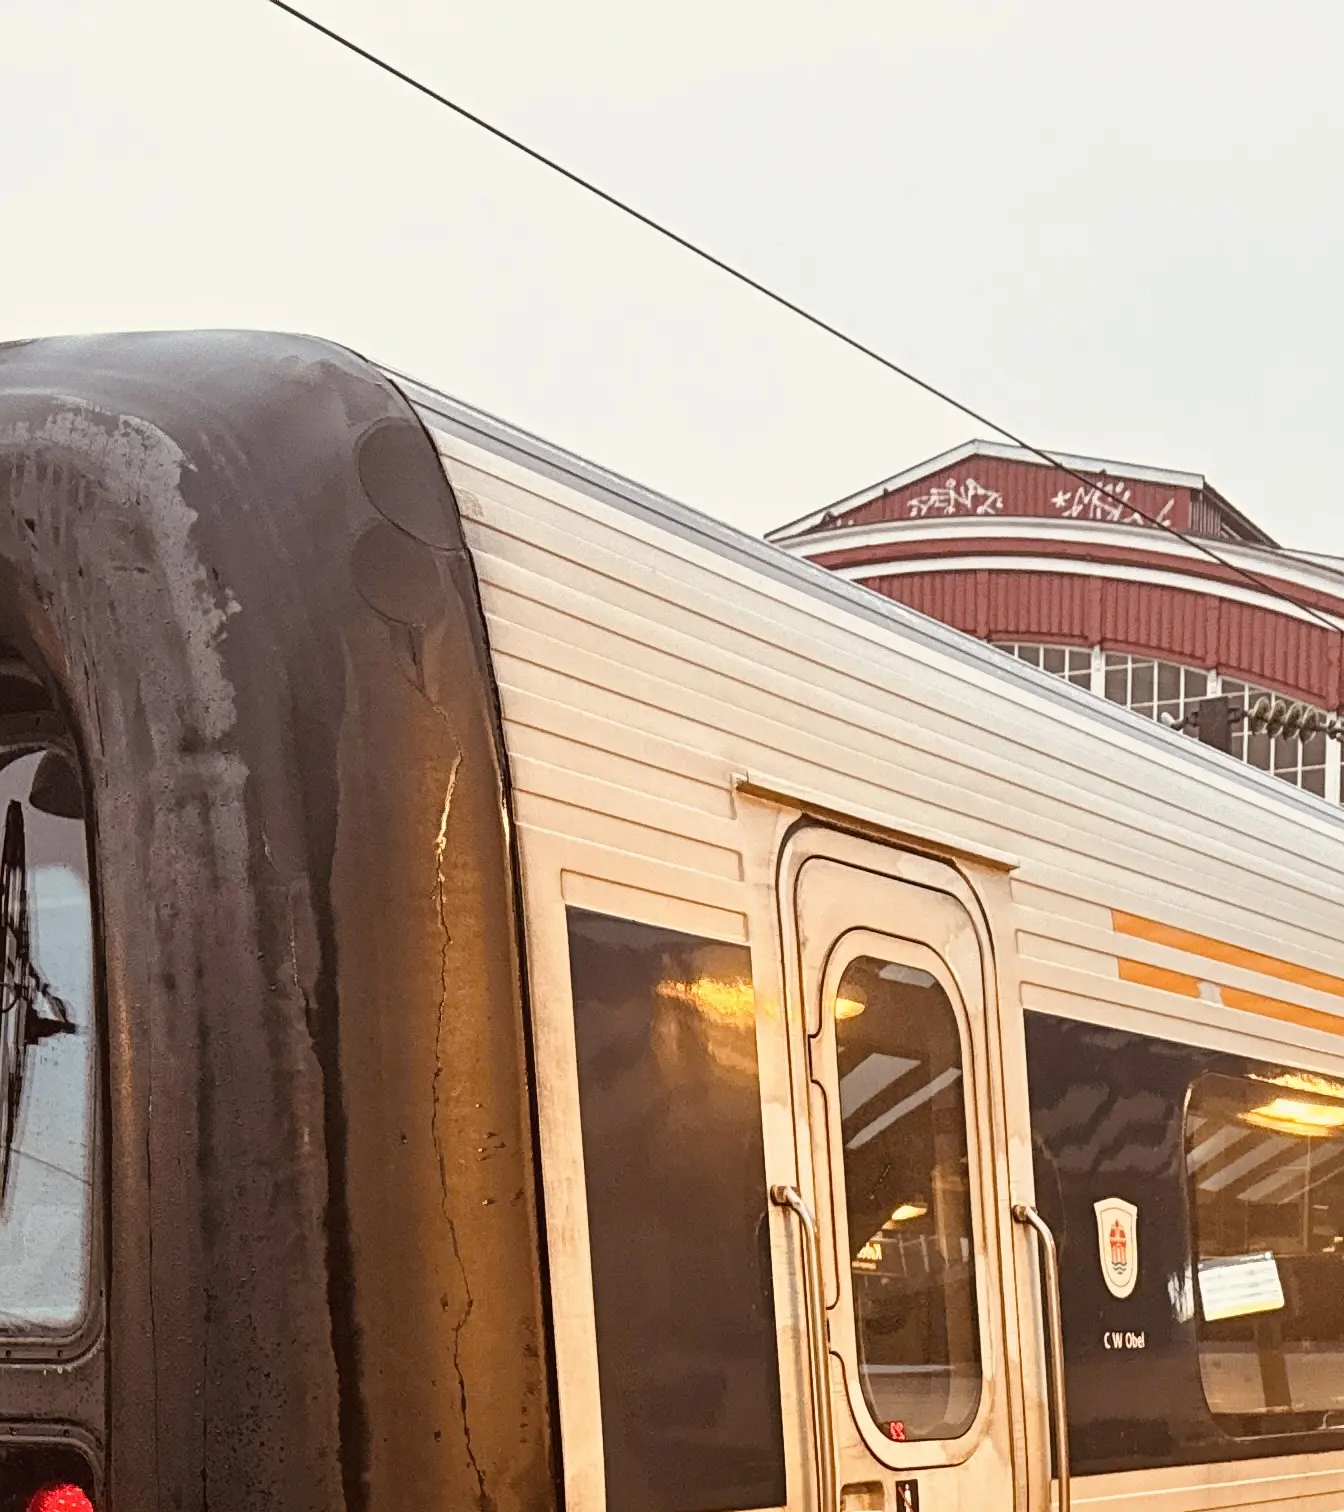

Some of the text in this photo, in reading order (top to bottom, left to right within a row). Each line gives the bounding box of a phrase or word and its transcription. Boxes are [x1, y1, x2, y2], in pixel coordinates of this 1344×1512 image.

[1103, 1331, 1145, 1349] C W Obel
